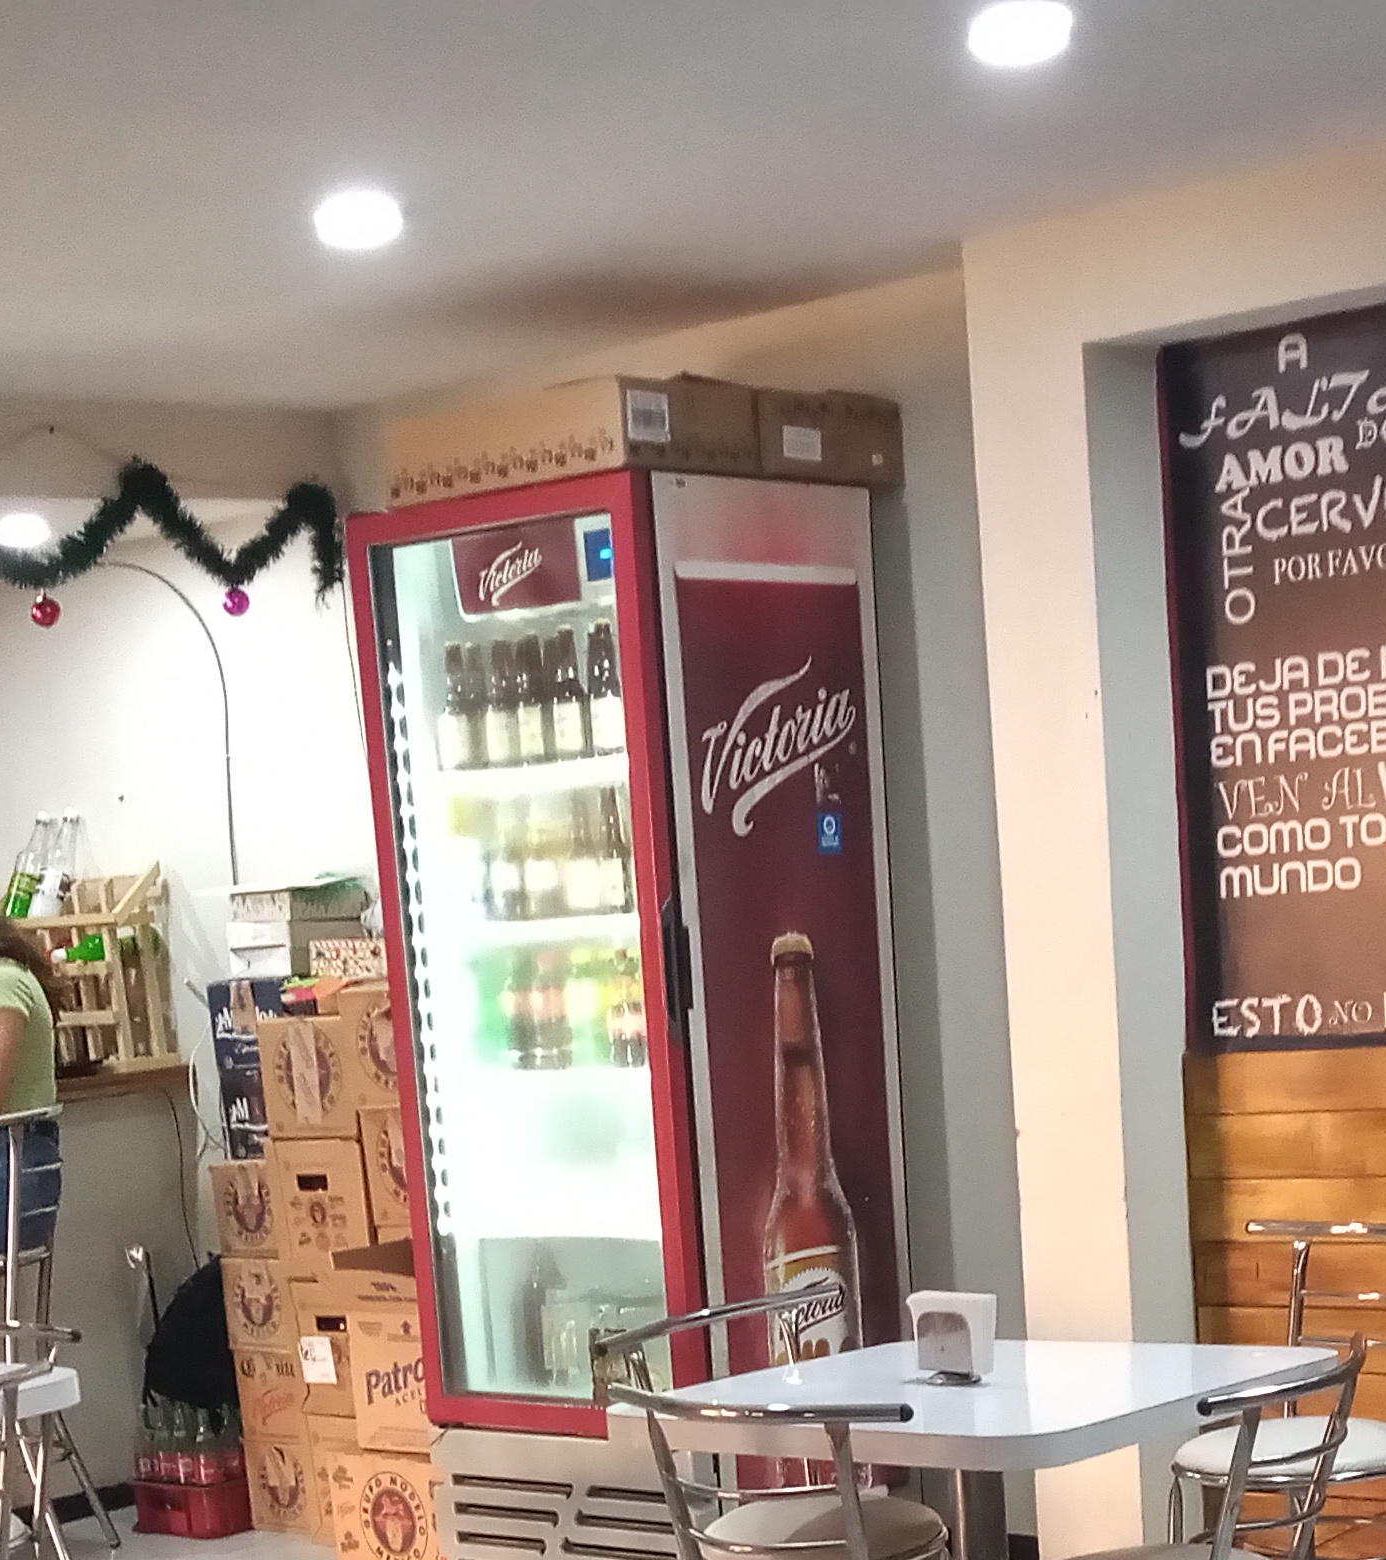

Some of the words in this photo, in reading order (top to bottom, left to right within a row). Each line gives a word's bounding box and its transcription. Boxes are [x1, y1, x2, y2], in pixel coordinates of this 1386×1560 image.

[1278, 333, 1309, 374] A
[1214, 435, 1349, 493] AMOR
[1221, 487, 1256, 625] OTRA
[1273, 552, 1321, 585] POR
[1205, 656, 1310, 700] DEJA
[1317, 648, 1372, 686] DE
[1207, 695, 1281, 734] TUS
[701, 655, 856, 836] Victoria
[1211, 734, 1262, 768] EN
[1215, 771, 1309, 821] VEN
[1321, 767, 1377, 811] AL
[1217, 817, 1330, 858] COMO
[1219, 857, 1362, 899] MUNDO
[1212, 993, 1322, 1037] ESTO
[1329, 999, 1373, 1027] NO
